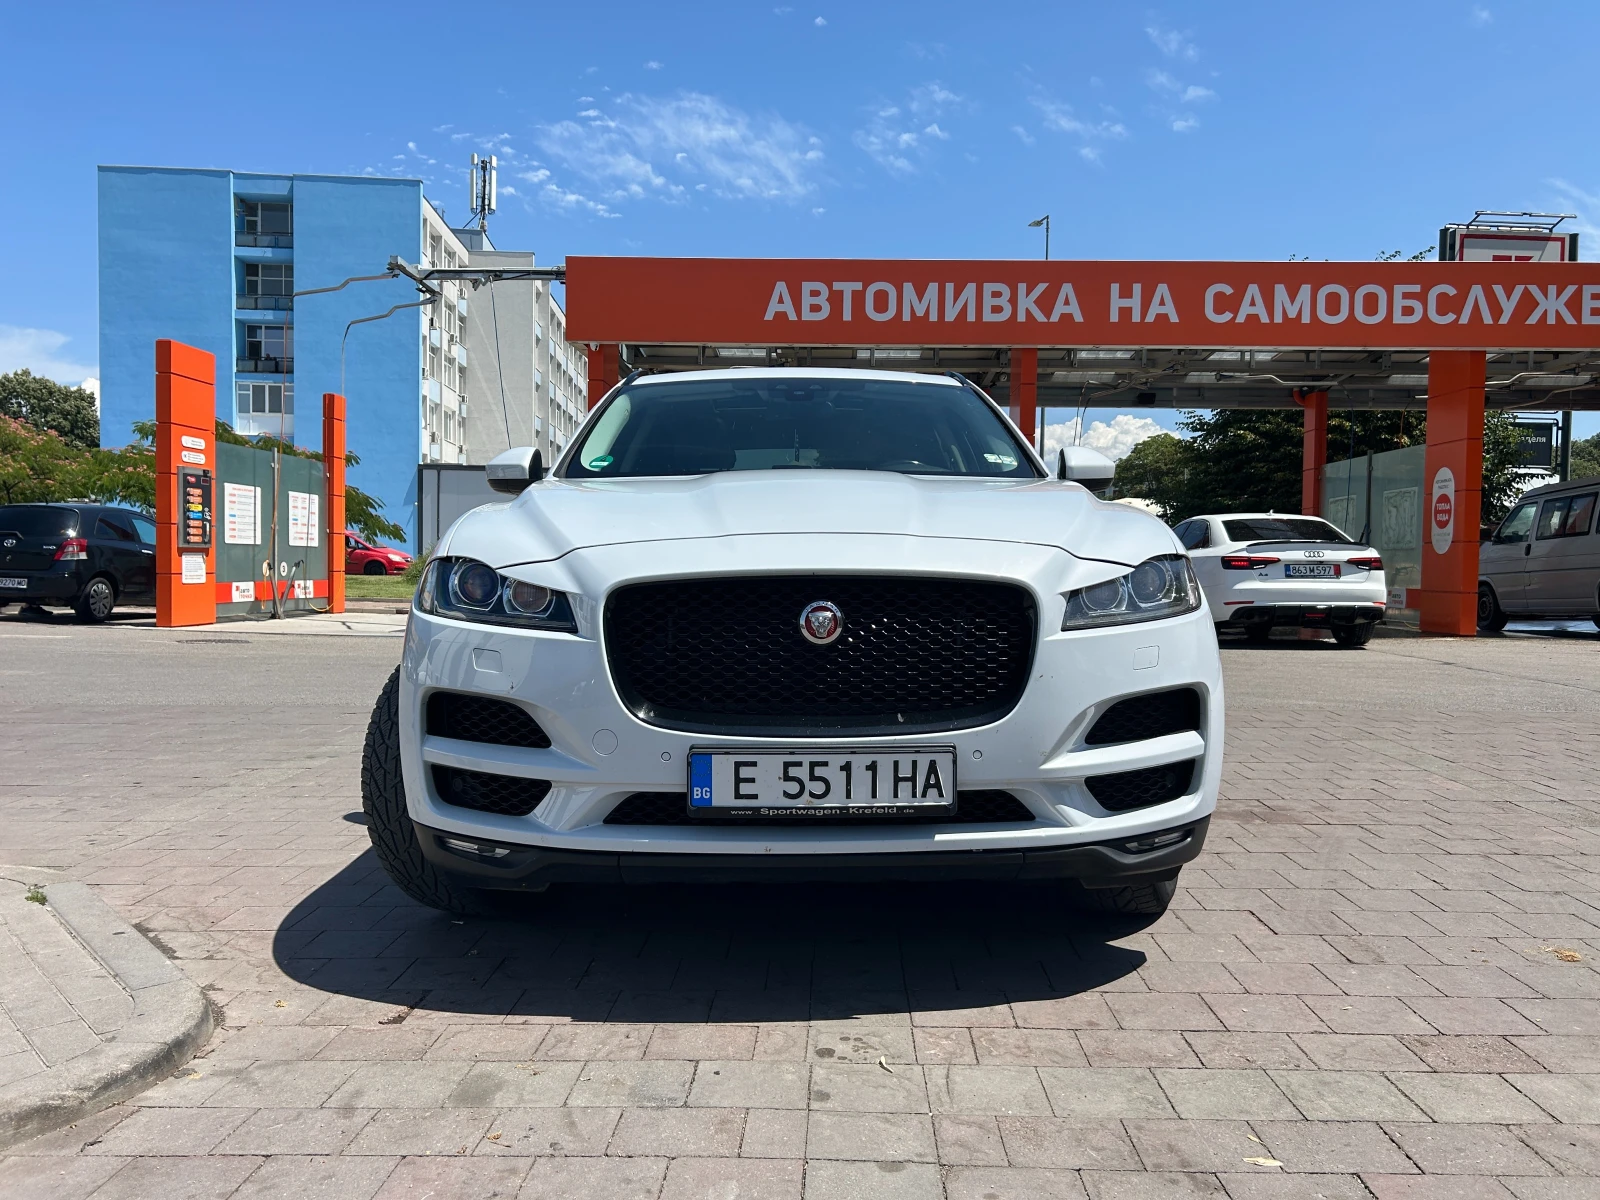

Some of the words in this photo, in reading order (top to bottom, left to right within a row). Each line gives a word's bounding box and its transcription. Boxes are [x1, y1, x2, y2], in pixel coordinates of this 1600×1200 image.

[764, 281, 1084, 323] АВТОМИВКА
[1109, 283, 1180, 322] НА
[1204, 283, 1600, 325] САМООБСЛУЖЕ
[1436, 513, 1449, 521] ВОДА
[1291, 565, 1332, 575] 863M597
[733, 760, 759, 799] E
[693, 787, 711, 799] BG
